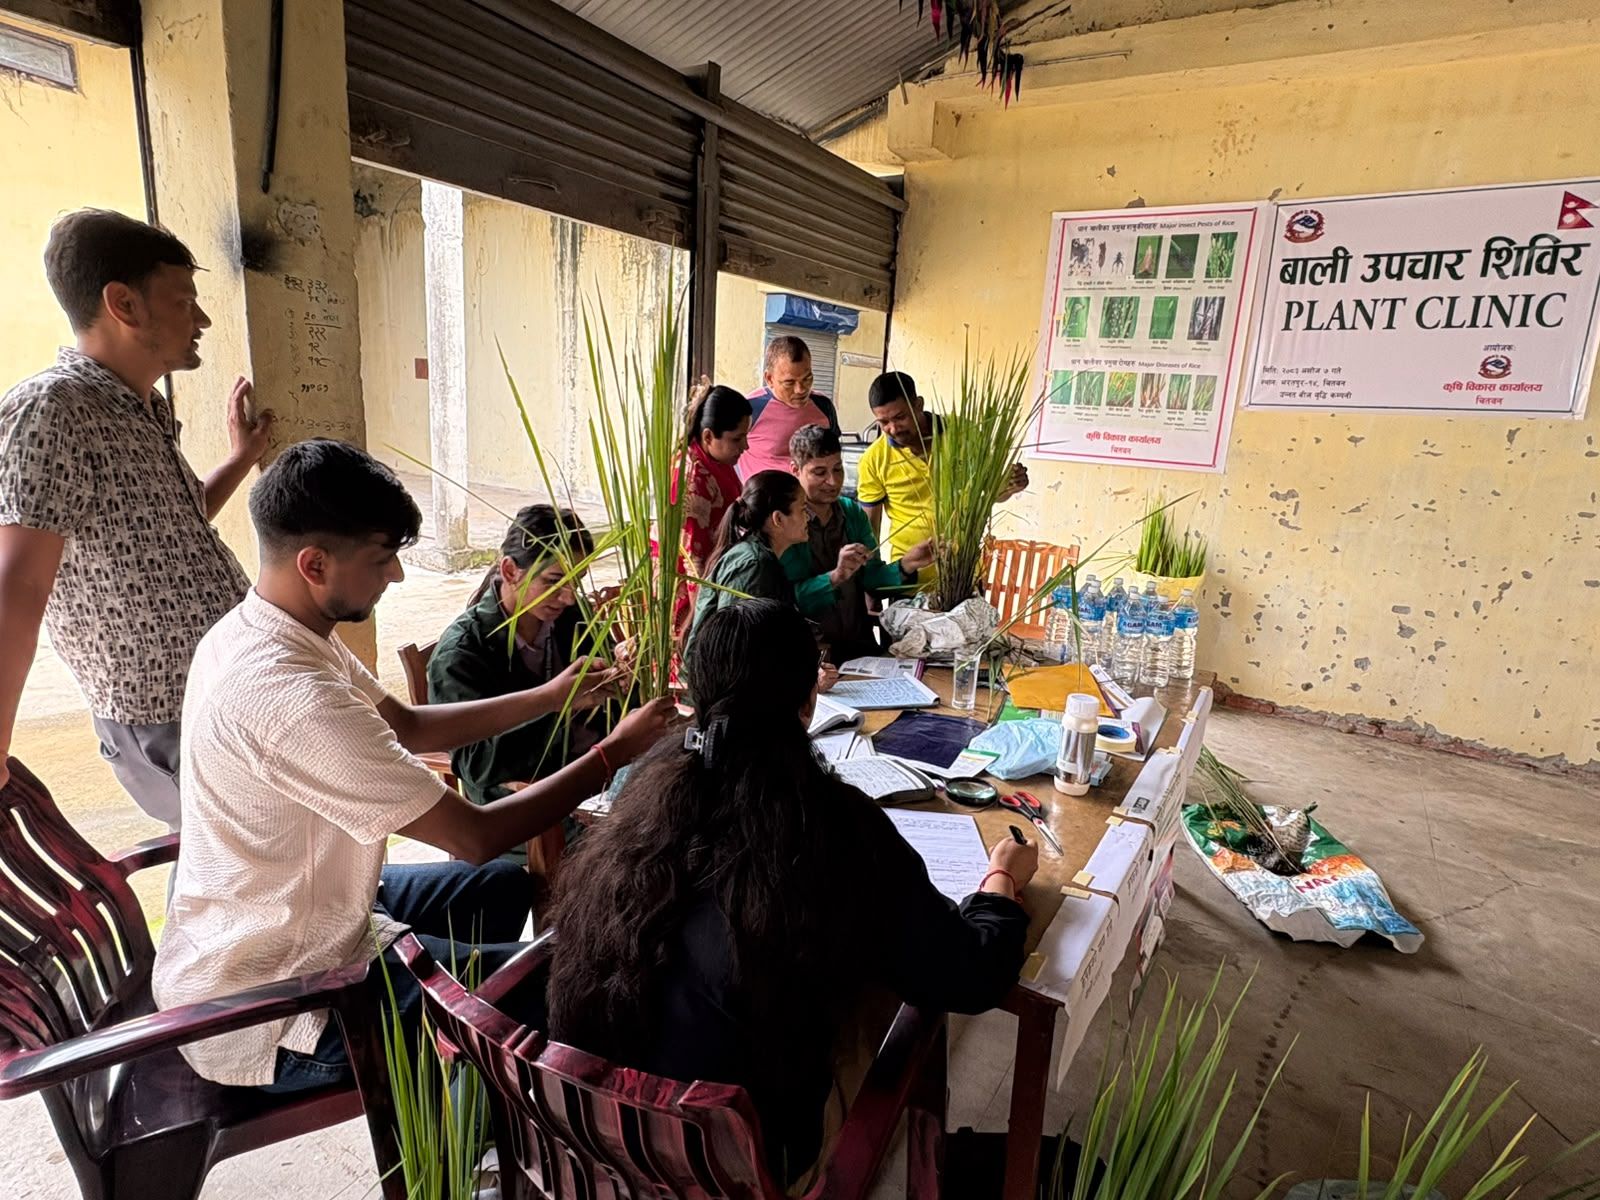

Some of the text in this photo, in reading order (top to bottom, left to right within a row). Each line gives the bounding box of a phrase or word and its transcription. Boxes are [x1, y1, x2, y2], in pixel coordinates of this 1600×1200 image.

[1159, 222, 1178, 230] Major
[1222, 219, 1235, 227] Rice
[1279, 233, 1591, 286] बाली उपचार शिविर
[1281, 292, 1568, 332] PLANT CLINIC
[1138, 360, 1202, 370] Major Diseases of Rice
[1323, 378, 1346, 387] चितवन
[1443, 380, 1543, 393] कृषि विकास कार्यालय
[1475, 394, 1504, 405] चितवन
[1086, 431, 1163, 445] कृषि विकास कार्यालय
